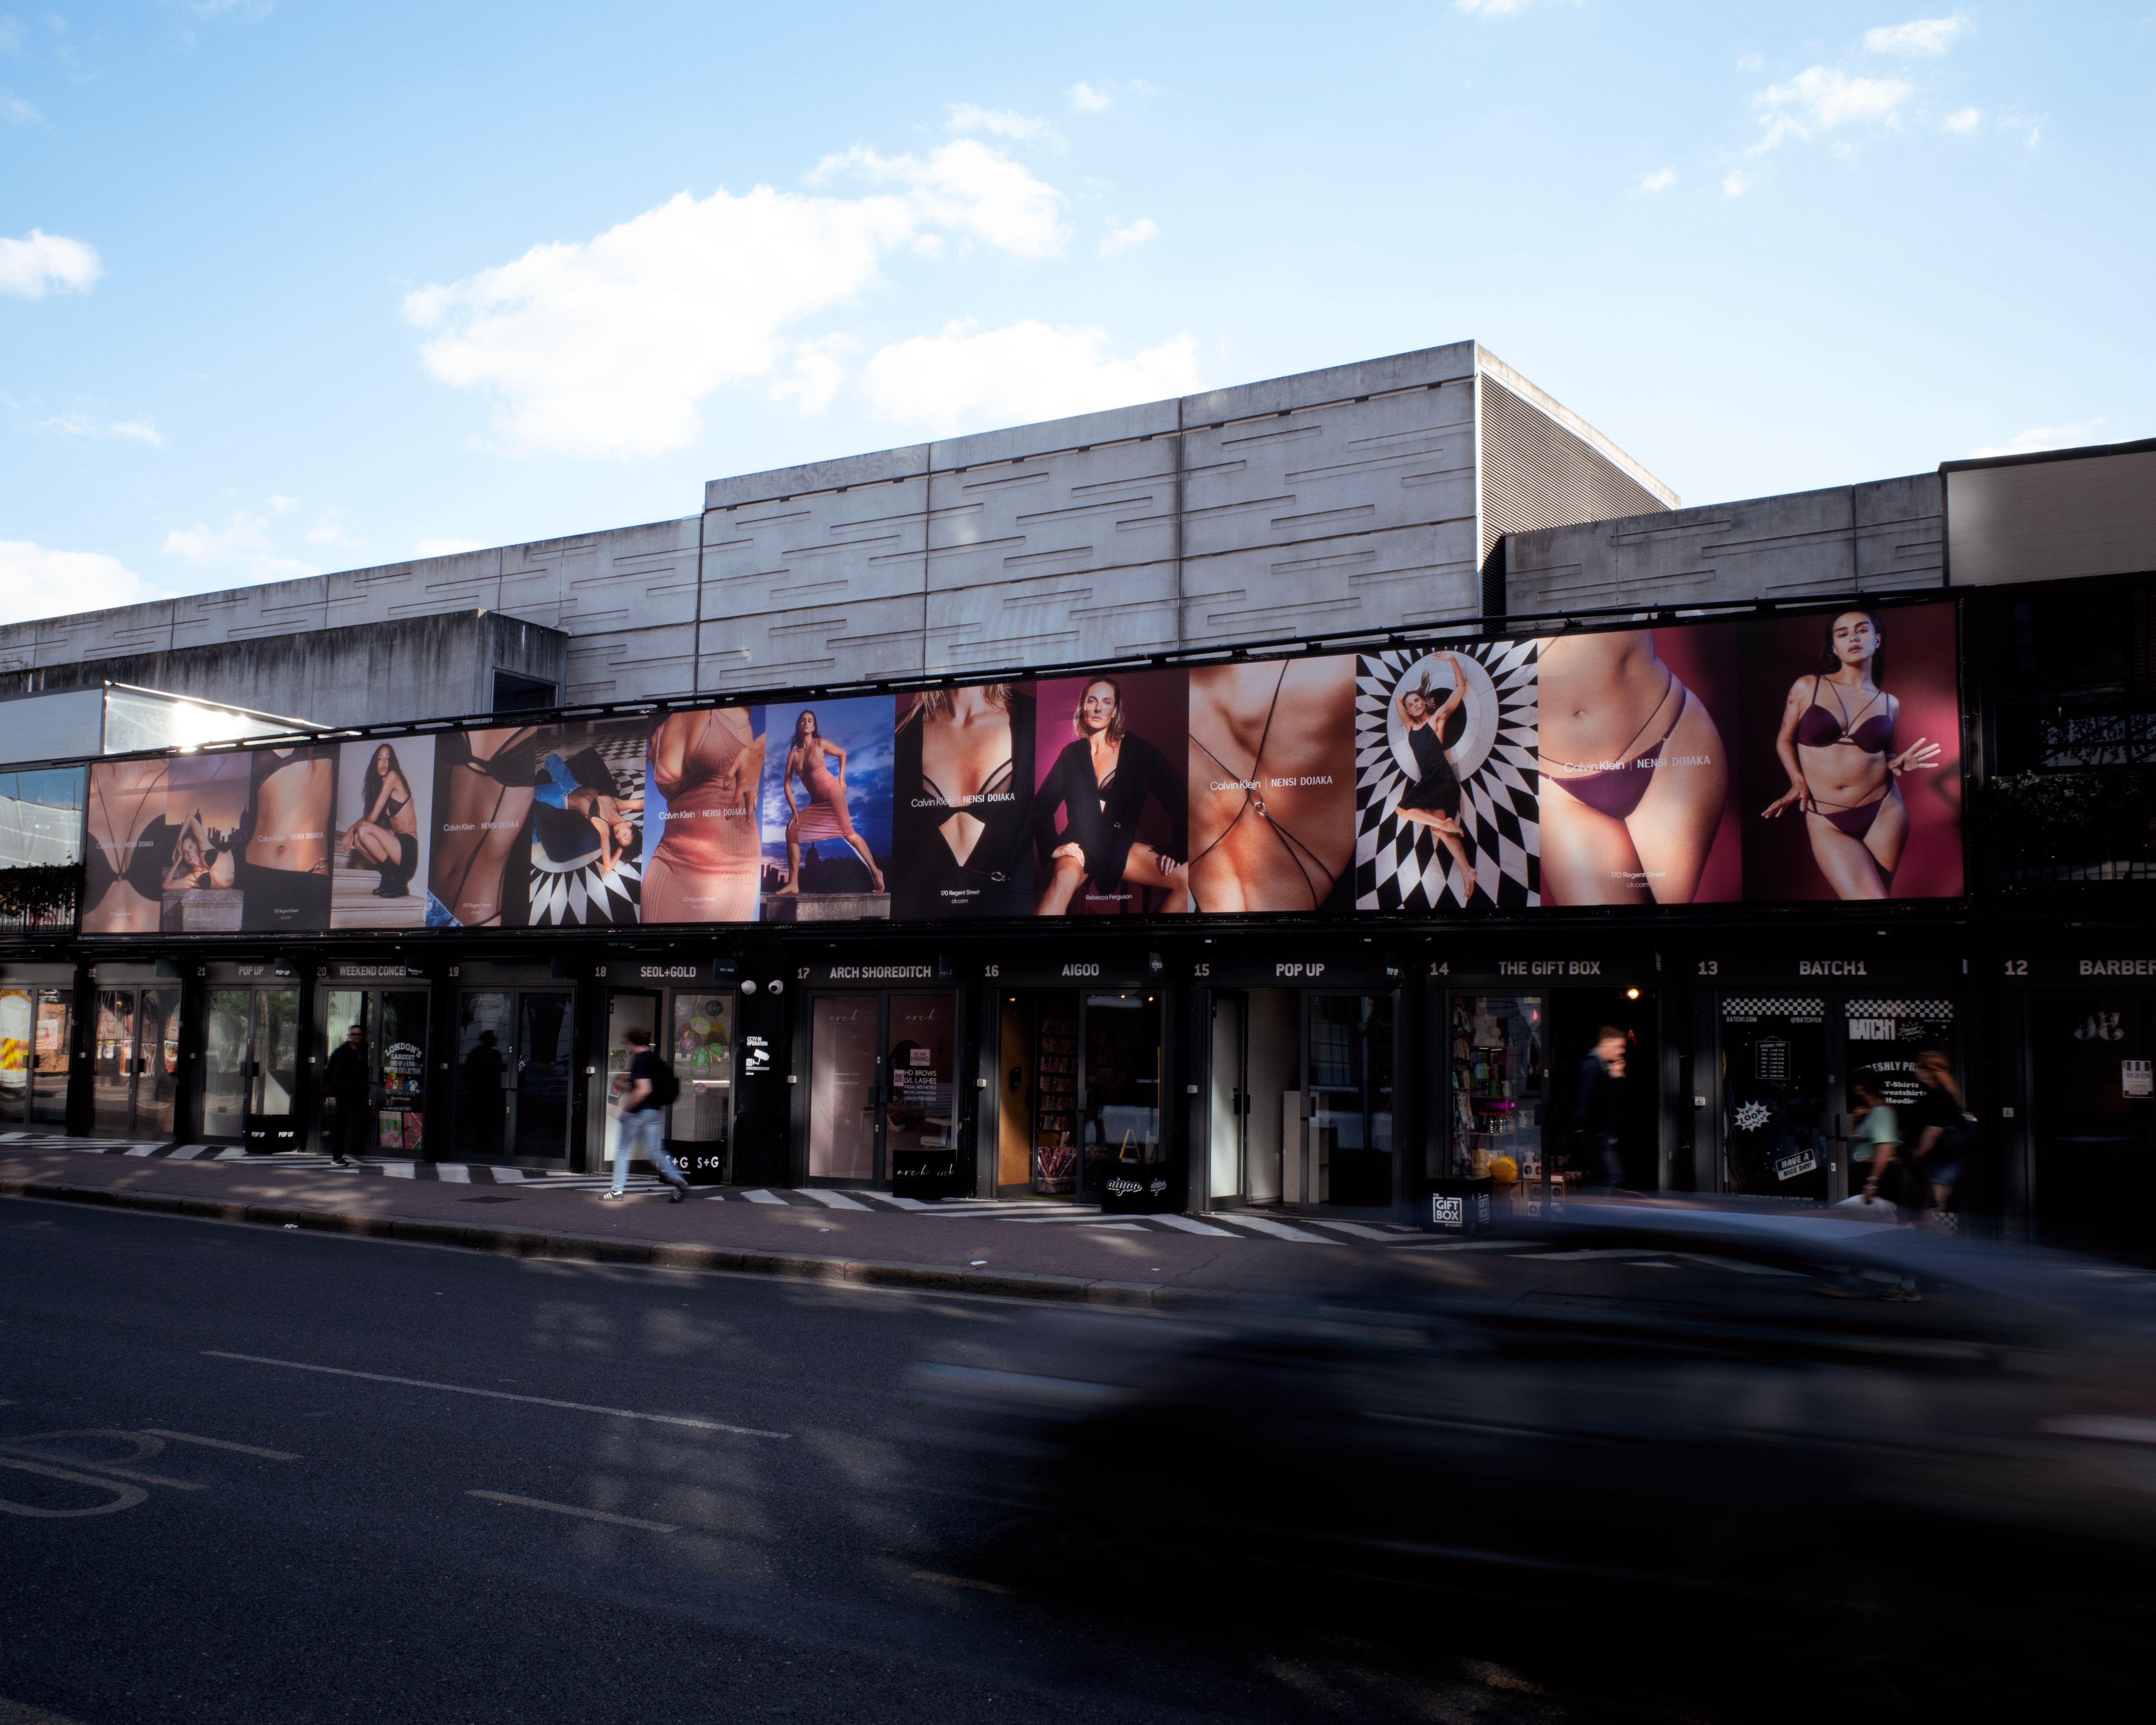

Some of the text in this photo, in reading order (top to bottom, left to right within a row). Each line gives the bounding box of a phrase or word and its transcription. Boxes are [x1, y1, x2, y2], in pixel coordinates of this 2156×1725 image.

[1564, 756, 1711, 772] Calvin Klein NENSI DOJAKA
[1210, 775, 1332, 790] Calvin Klein NENSI DOJAKA
[912, 793, 1015, 807] Calvin Klein NENSI DOJAKA
[659, 811, 679, 819] Calvin
[702, 809, 721, 817] NENSI
[724, 808, 746, 816] DOJAKA
[88, 969, 96, 977] 22
[197, 967, 206, 976] 21
[239, 966, 264, 975] POP UP
[317, 967, 326, 976] 20
[340, 966, 376, 976] WEEKEND
[449, 967, 459, 977] 19
[595, 966, 606, 977] 18
[641, 966, 696, 977] SEOL+GOLD
[798, 968, 809, 979] 17
[830, 966, 931, 979] ARCH SHOREDITCH
[984, 965, 999, 977] 16
[1062, 963, 1099, 976] AIGOO
[1194, 964, 1210, 976] 15
[1276, 963, 1325, 976] POP UP
[1430, 962, 1449, 975] 14
[1498, 961, 1601, 975] THE GIFT BOX
[1698, 961, 1718, 975] 13
[1799, 961, 1867, 975] BATCH1
[2004, 960, 2028, 975] 12
[829, 1010, 860, 1021] arch
[906, 1009, 938, 1021] arch
[1849, 1019, 1896, 1040] BATCH1
[385, 1042, 422, 1058] LONDON'S
[1739, 1107, 1764, 1124] LOOK
[1741, 1106, 1753, 1115] YOU
[697, 1156, 719, 1169] S+G
[1781, 1152, 1809, 1169] HAVE A
[897, 1164, 930, 1176] arch
[937, 1164, 954, 1176] arch
[1783, 1162, 1812, 1176] NICE DAY!
[1106, 1176, 1142, 1196] aigoo
[1150, 1177, 1167, 1196] aigoo
[1436, 1200, 1459, 1210] GIFT
[1436, 1210, 1459, 1220] BOX
